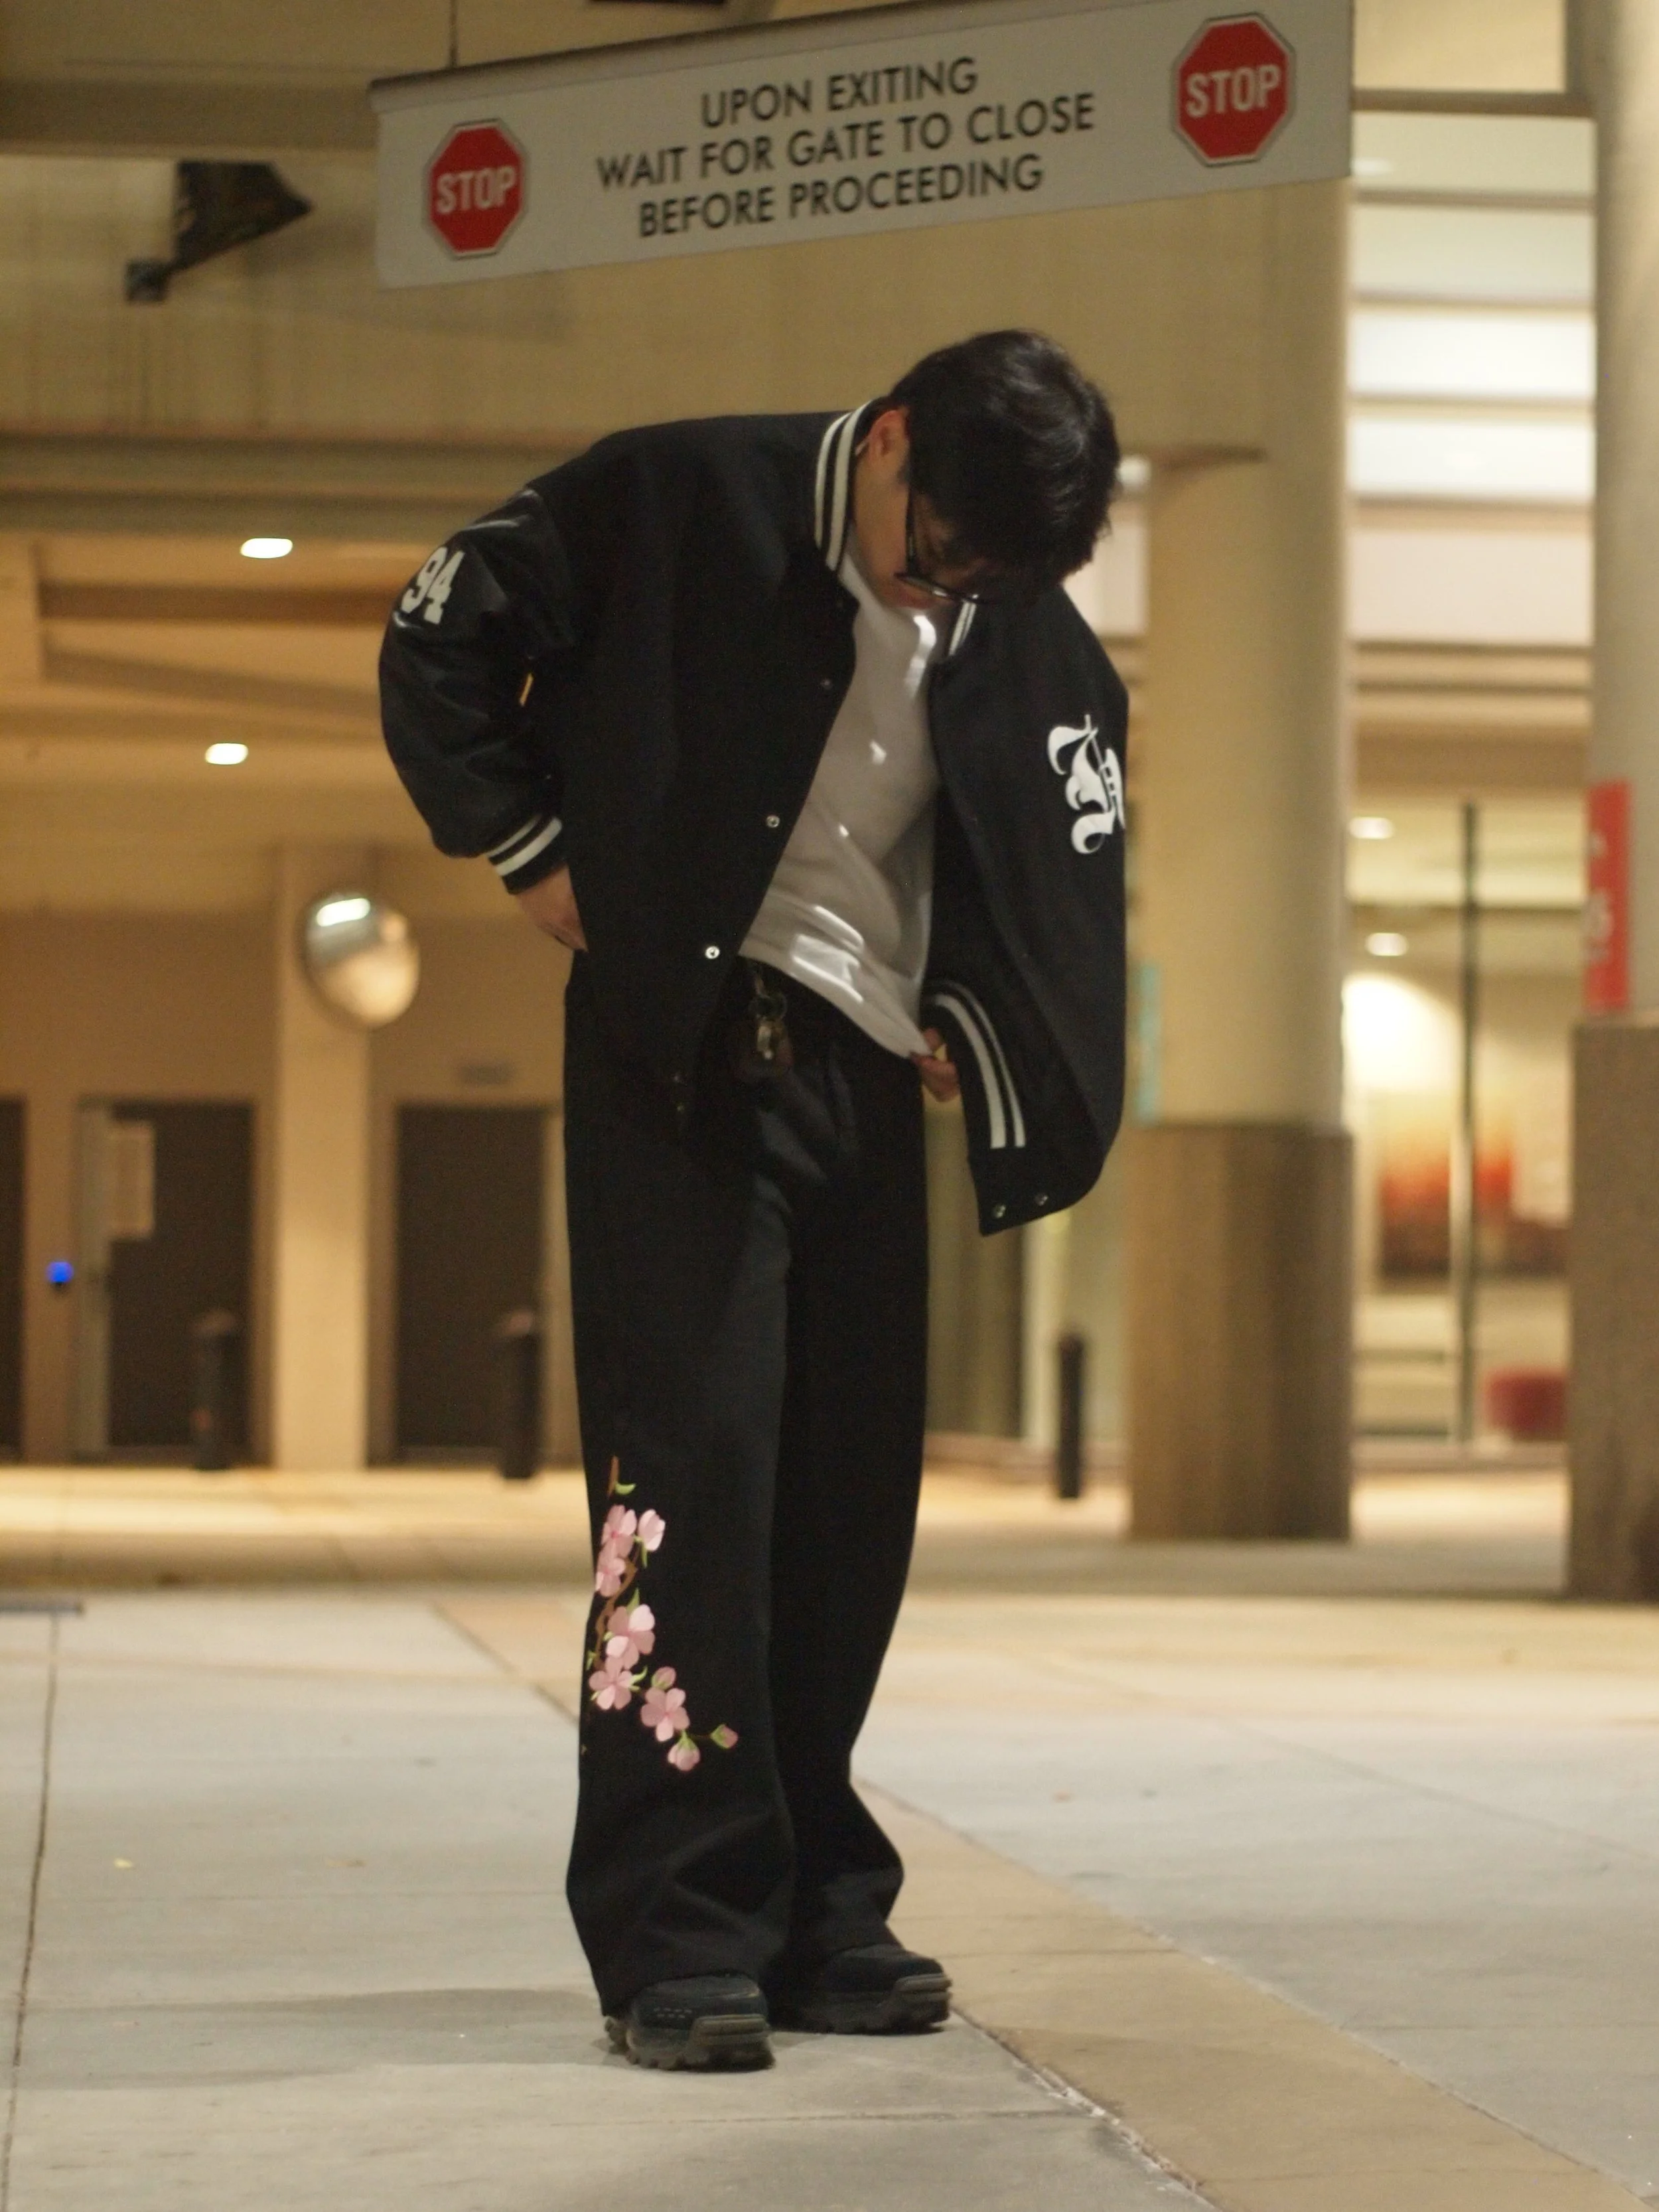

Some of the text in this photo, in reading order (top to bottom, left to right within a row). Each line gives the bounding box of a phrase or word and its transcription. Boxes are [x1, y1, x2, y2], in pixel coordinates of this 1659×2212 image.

[701, 56, 978, 129] UPON EXITING
[1186, 64, 1281, 118] STOP
[596, 92, 1094, 188] WAIT FOR GATE TO CLOSE
[436, 165, 518, 214] STOP
[639, 153, 1044, 238] BEFORE PROCEEDING
[401, 546, 465, 625] 94
